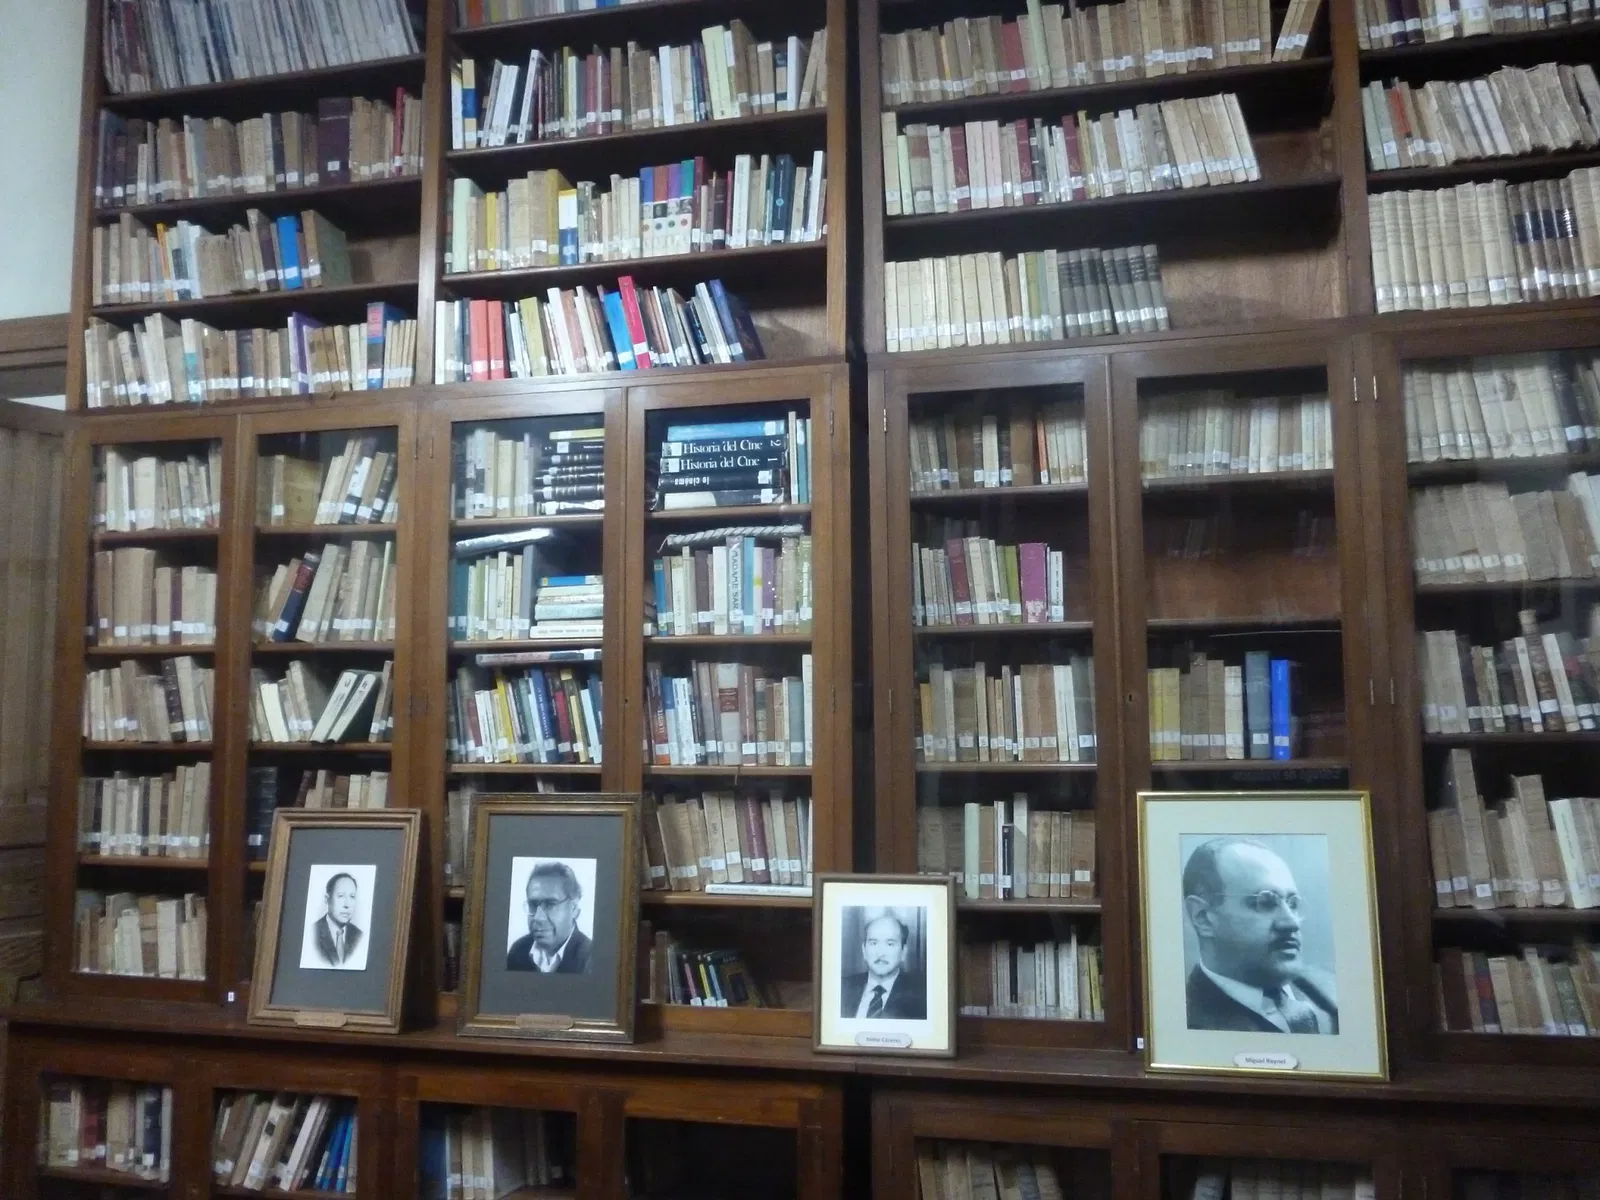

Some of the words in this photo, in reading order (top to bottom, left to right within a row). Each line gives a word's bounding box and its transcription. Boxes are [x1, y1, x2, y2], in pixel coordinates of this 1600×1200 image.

[684, 442, 720, 454] Historia
[722, 441, 737, 452] del
[740, 439, 763, 451] Cine
[681, 458, 717, 470] Historia
[720, 457, 734, 468] del
[737, 455, 760, 467] Cine
[1245, 1057, 1265, 1065] Miguel
